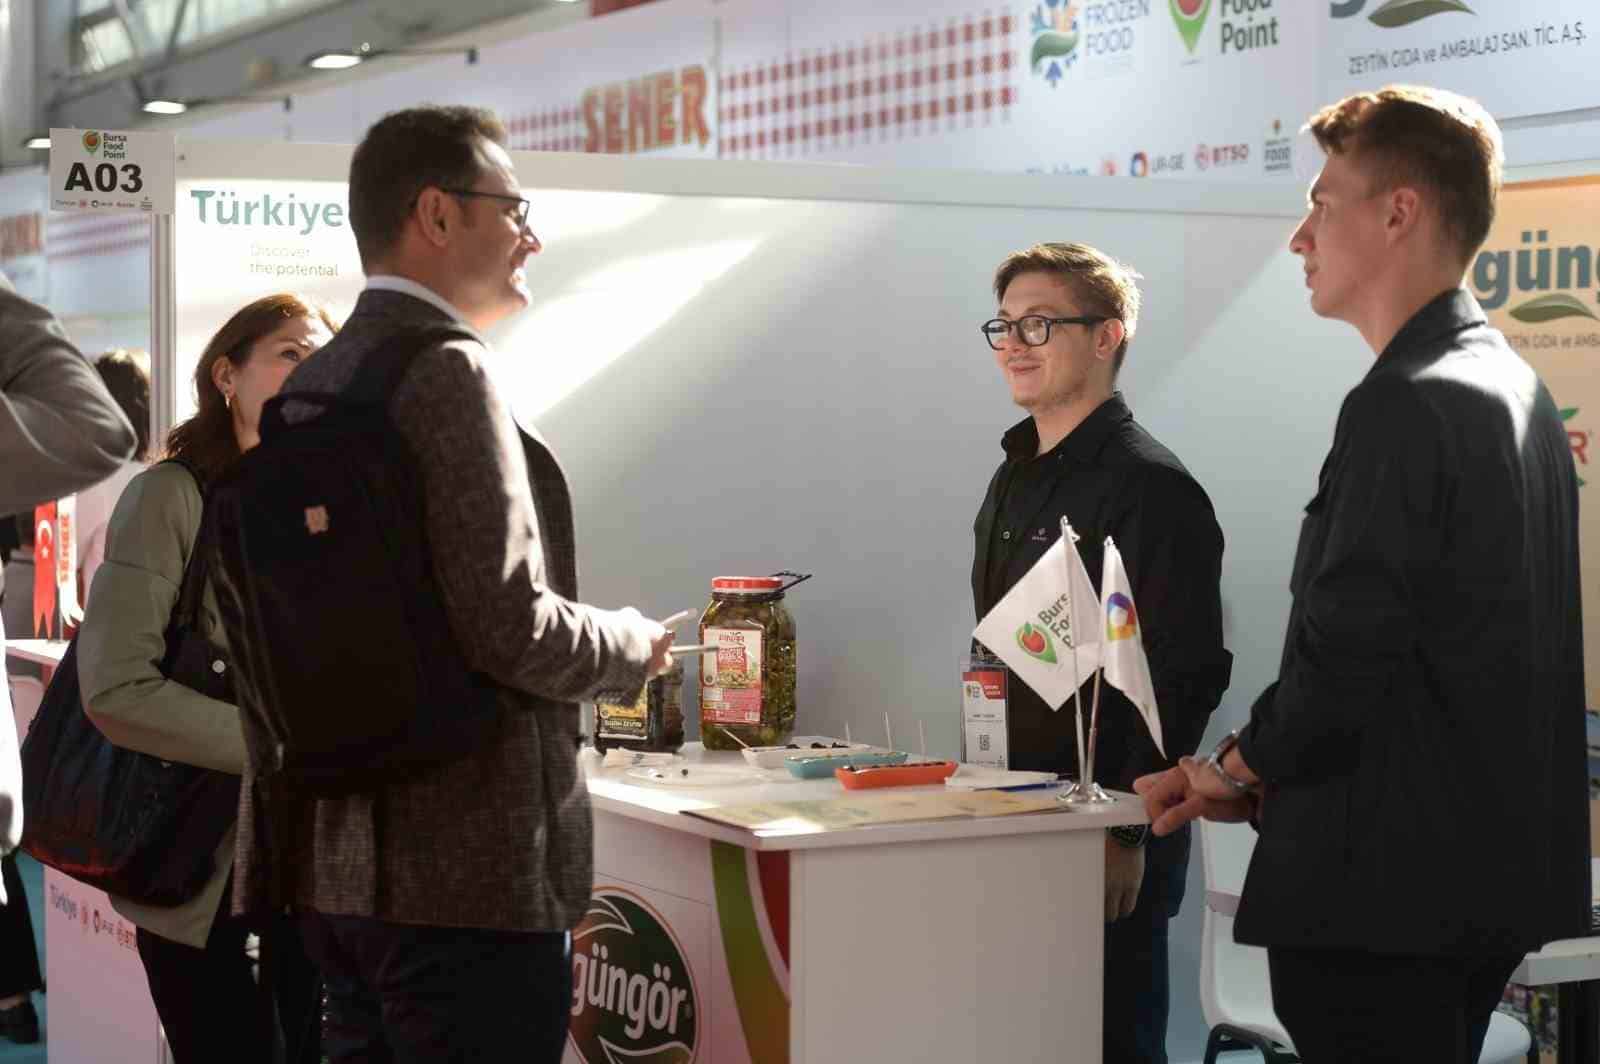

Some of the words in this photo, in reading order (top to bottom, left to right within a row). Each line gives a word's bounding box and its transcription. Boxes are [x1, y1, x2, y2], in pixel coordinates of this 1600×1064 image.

[1086, 27, 1134, 55] FOOD
[1221, 17, 1278, 53] Point
[102, 132, 127, 143] Bursa
[102, 142, 125, 151] Food
[102, 151, 126, 160] Point
[64, 162, 143, 193] A03
[190, 189, 344, 236] Türkiye
[276, 263, 339, 278] potential
[570, 942, 687, 1040] güngör
